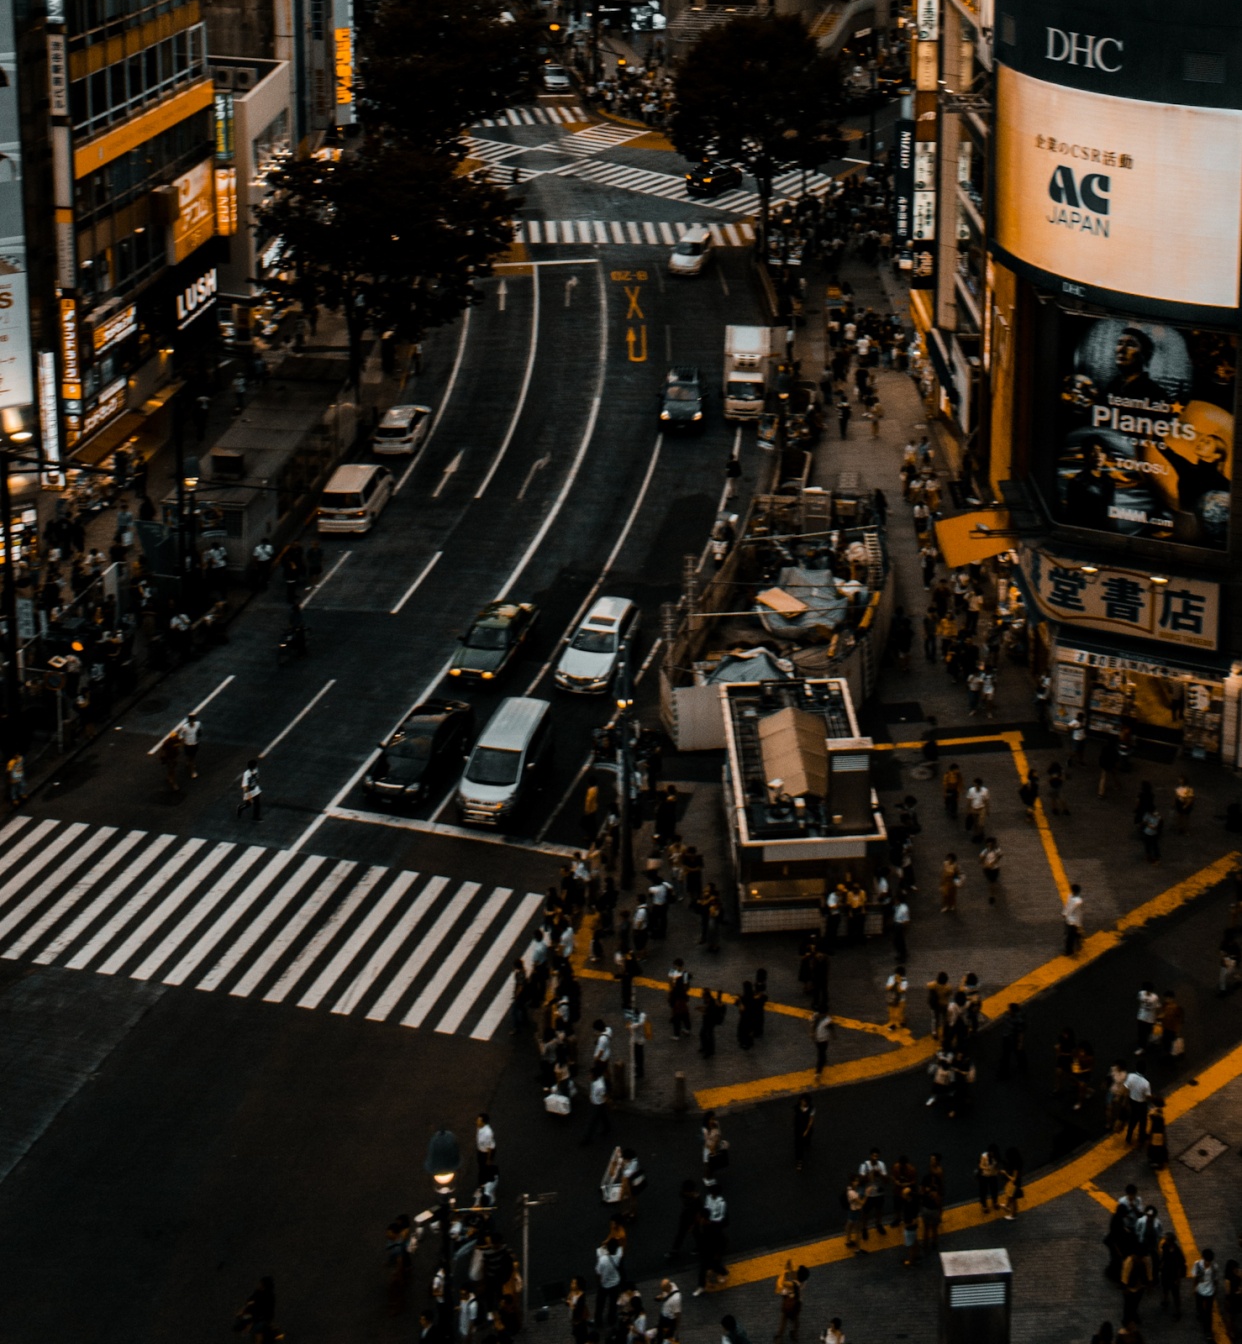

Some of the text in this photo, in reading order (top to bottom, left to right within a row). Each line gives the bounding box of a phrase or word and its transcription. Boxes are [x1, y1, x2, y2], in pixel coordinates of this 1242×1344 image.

[1045, 26, 1124, 73] DHC
[899, 131, 911, 169] MIZUHO
[1035, 134, 1135, 170] 企業のCSR活動
[1049, 165, 1110, 216] AC
[1046, 207, 1110, 238] JAPAN
[175, 267, 218, 321] LUSH
[1062, 281, 1087, 297] DHC
[1107, 392, 1171, 414] teamLab
[1092, 403, 1197, 442] Planets
[1122, 435, 1168, 451] TOKYO
[1115, 457, 1170, 476] TOYOSU
[1031, 548, 1206, 634] 堂書店
